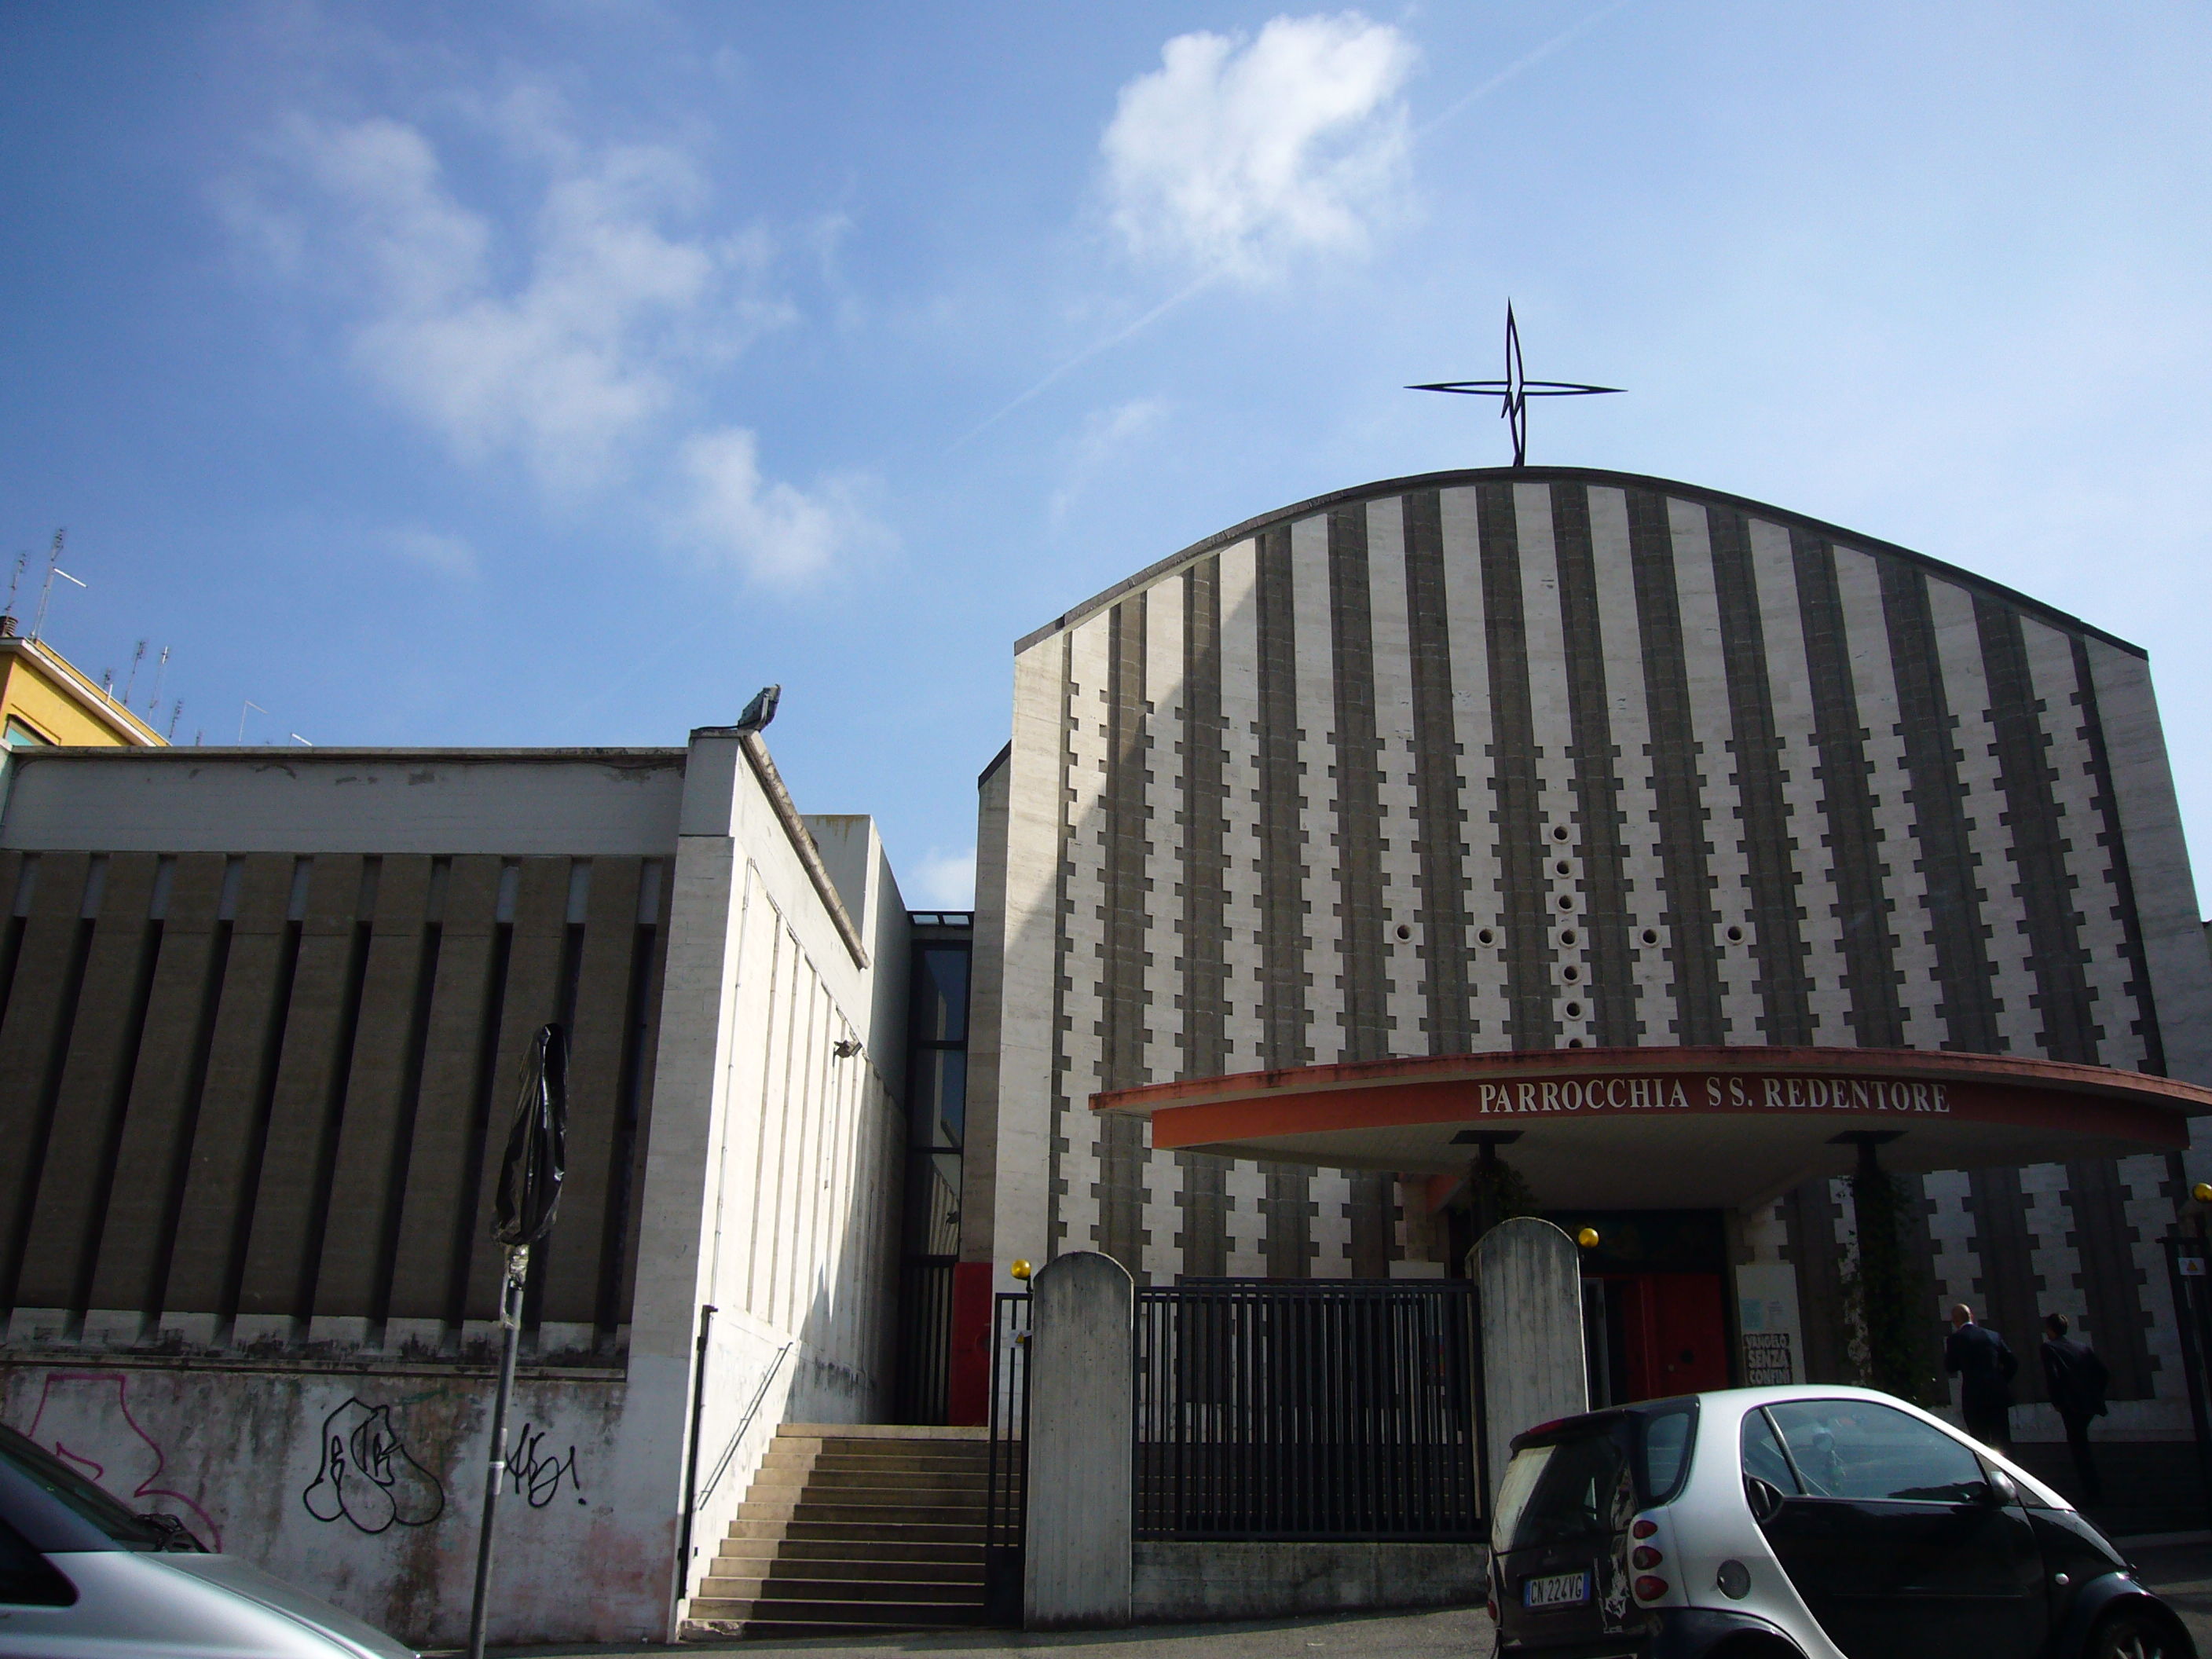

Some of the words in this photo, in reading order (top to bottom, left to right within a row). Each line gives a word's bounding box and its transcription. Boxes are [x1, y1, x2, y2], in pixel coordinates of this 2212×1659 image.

[1478, 1078, 1690, 1114] PARROCCHIA
[1707, 1076, 1753, 1108] SS.
[1763, 1077, 1951, 1113] REDENTORE
[1748, 1349, 1789, 1368] SENZA
[1749, 1369, 1791, 1385] CONFINI
[1531, 1580, 1544, 1604] CN
